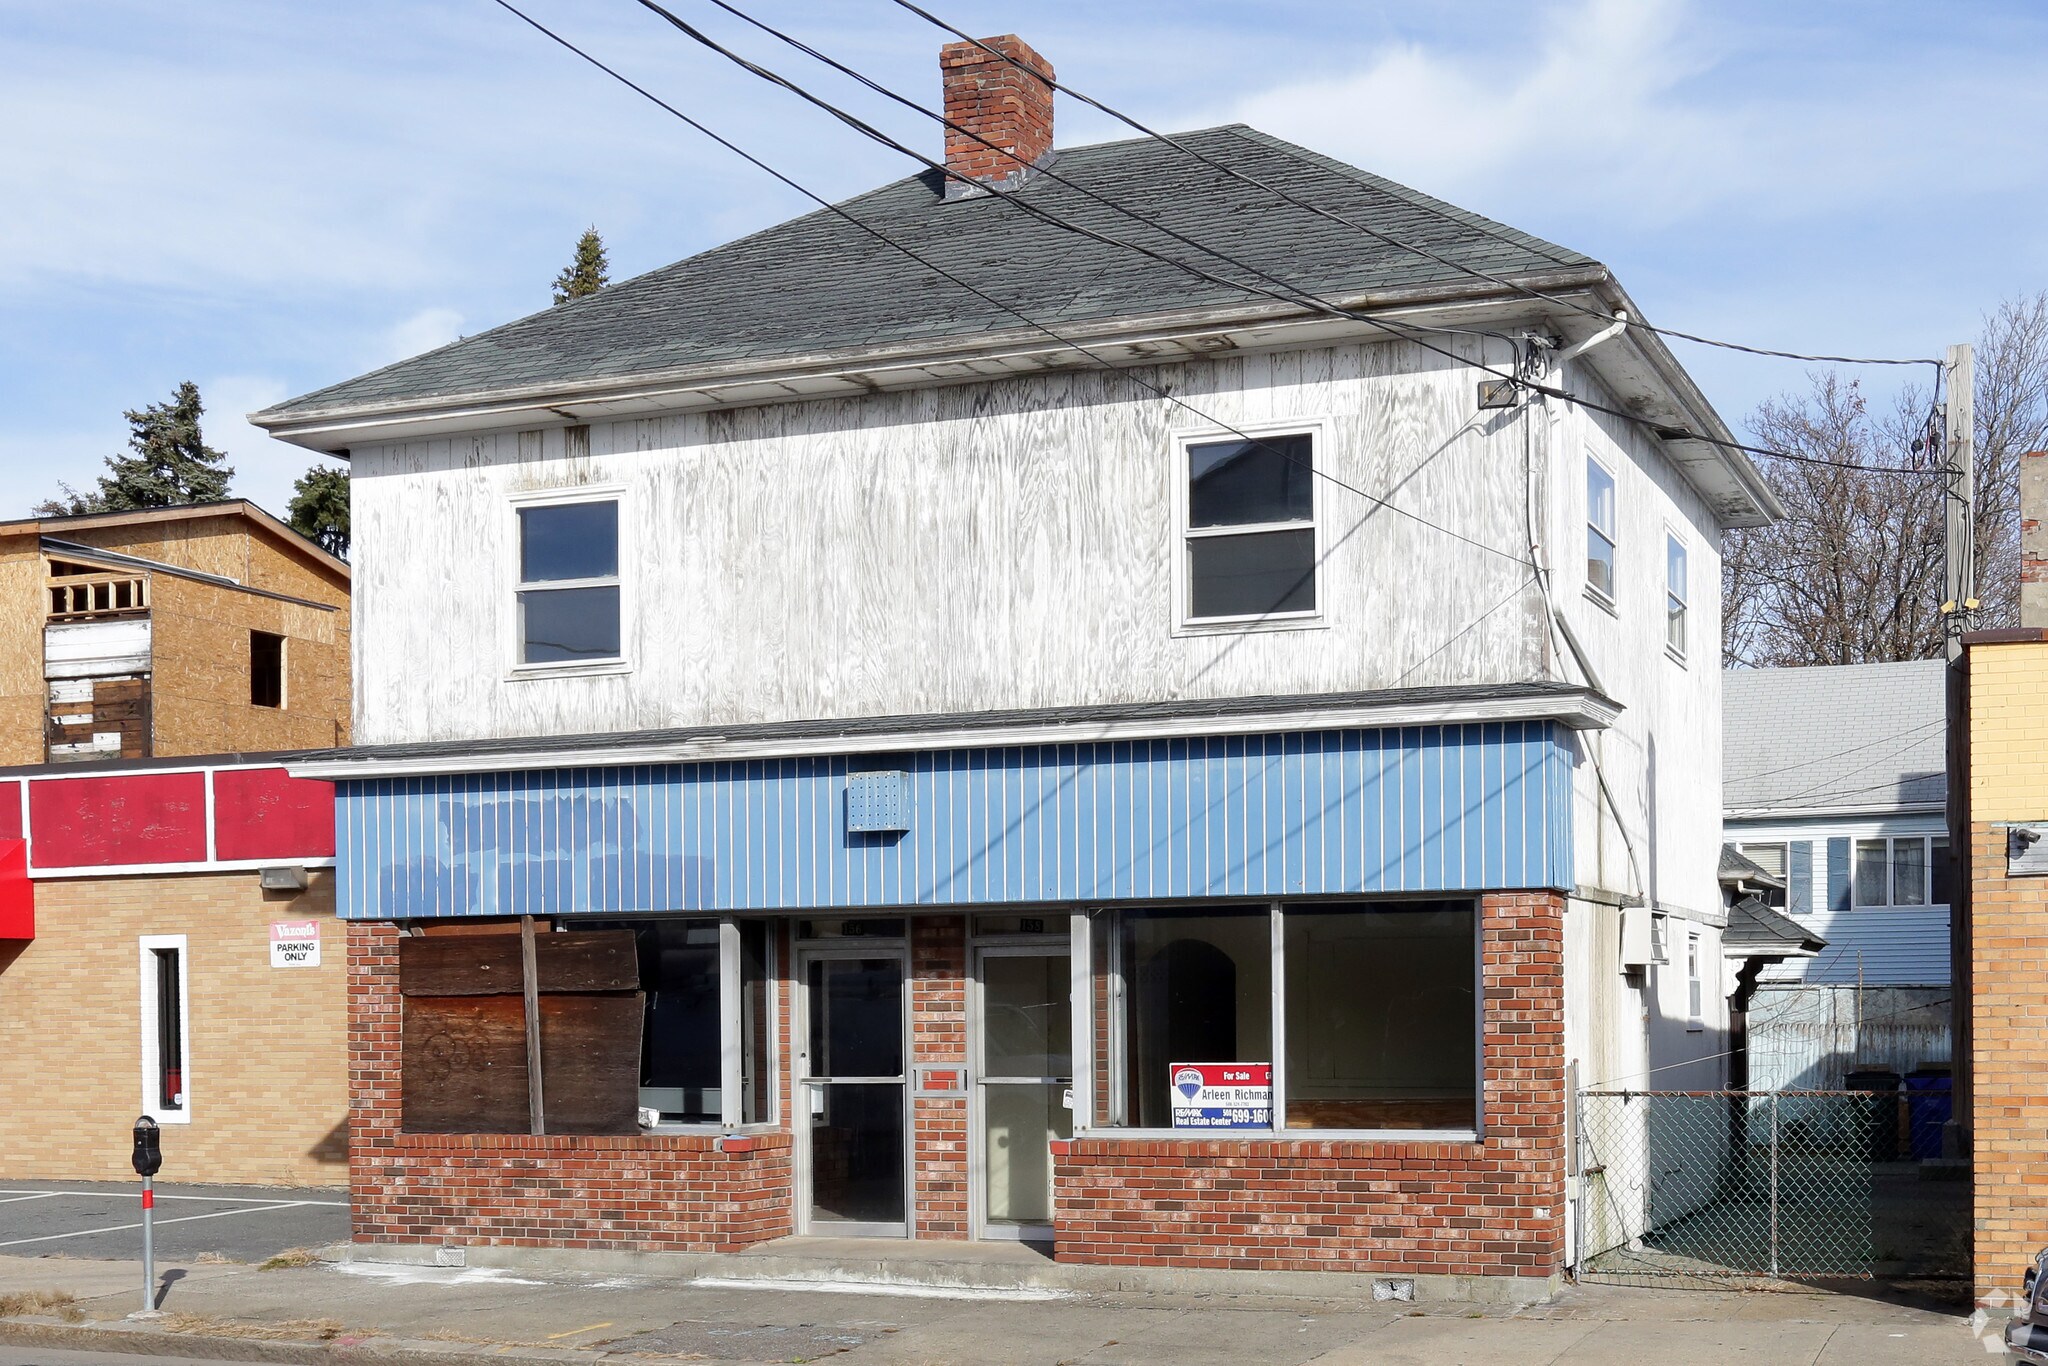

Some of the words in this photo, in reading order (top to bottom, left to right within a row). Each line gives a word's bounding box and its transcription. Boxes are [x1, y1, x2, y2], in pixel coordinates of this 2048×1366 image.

[843, 922, 862, 935] 156
[277, 942, 315, 952] PARKING
[284, 952, 307, 961] ONLY
[1223, 1071, 1235, 1080] For
[1235, 1071, 1250, 1080] Sale
[1202, 1089, 1230, 1100] Arleen
[1175, 1108, 1202, 1117] RE/MAX
[1175, 1117, 1190, 1125] Real
[1190, 1117, 1210, 1125] Estate
[1210, 1116, 1232, 1125] Center
